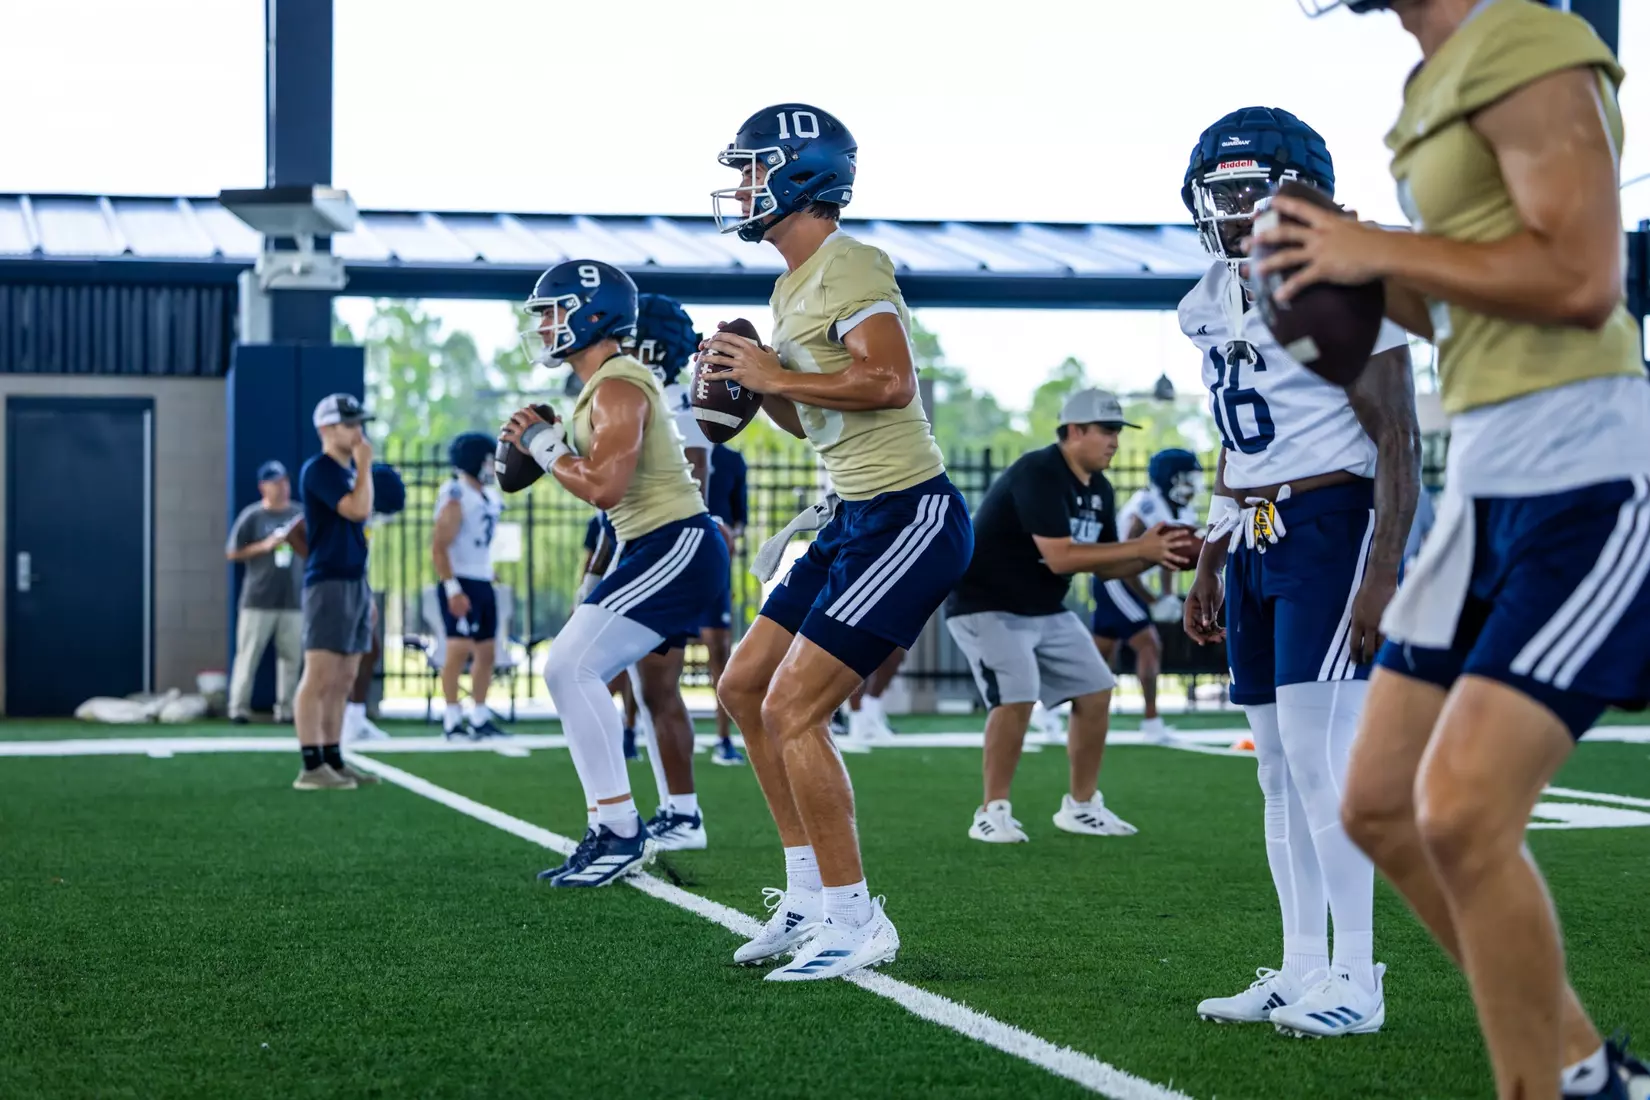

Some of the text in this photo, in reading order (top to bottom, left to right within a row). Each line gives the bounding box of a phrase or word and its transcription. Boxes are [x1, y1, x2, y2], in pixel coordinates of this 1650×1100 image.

[776, 110, 820, 140] 10
[1220, 159, 1253, 169] Riddell
[578, 264, 601, 288] 9
[1209, 341, 1275, 455] 16
